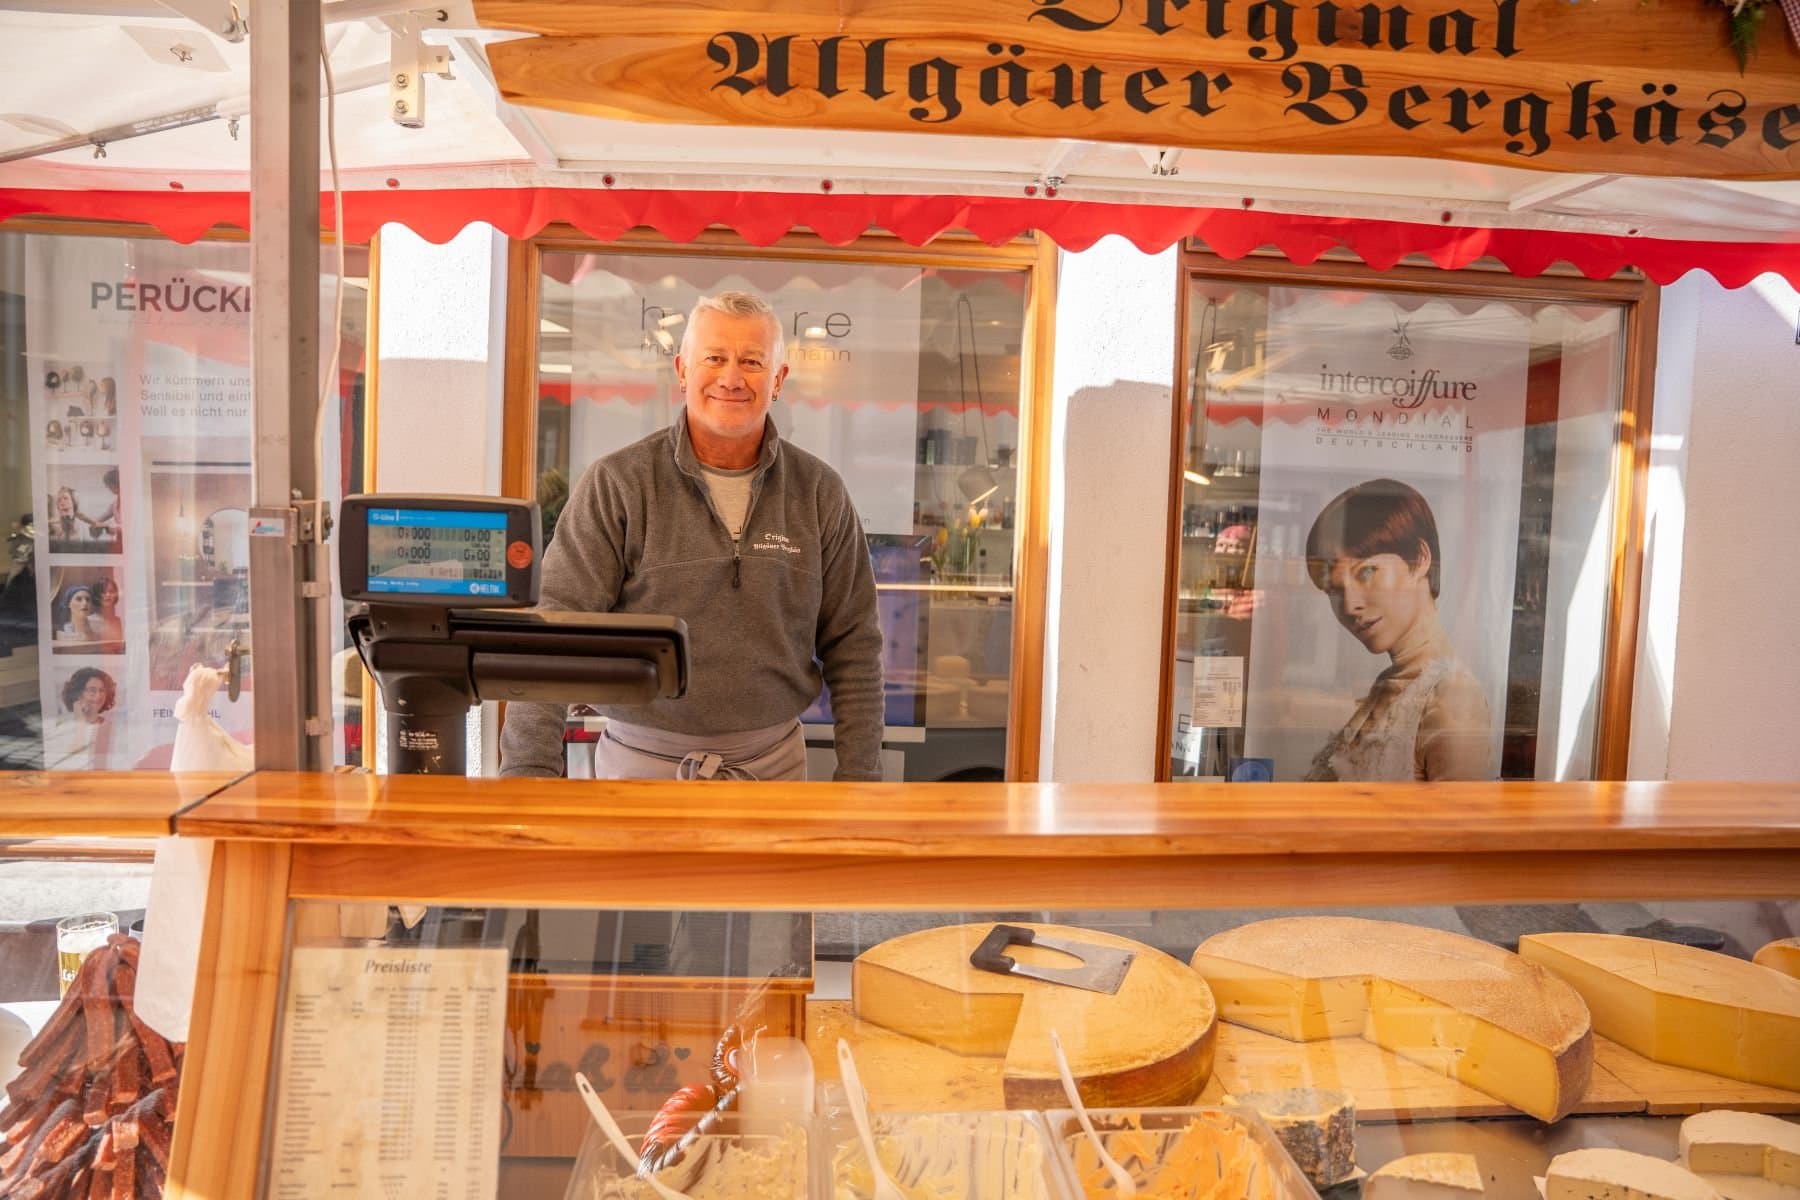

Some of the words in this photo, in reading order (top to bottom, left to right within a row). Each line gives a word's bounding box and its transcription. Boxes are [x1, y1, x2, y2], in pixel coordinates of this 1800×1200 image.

[706, 31, 1234, 124] Allgäuer
[1281, 60, 1800, 157] Bergkäse
[1319, 364, 1477, 409] intercoiffure
[199, 391, 224, 401] und
[190, 405, 222, 417] nicht
[1316, 407, 1473, 429] MONDIAL
[364, 959, 432, 974] Preisliste
